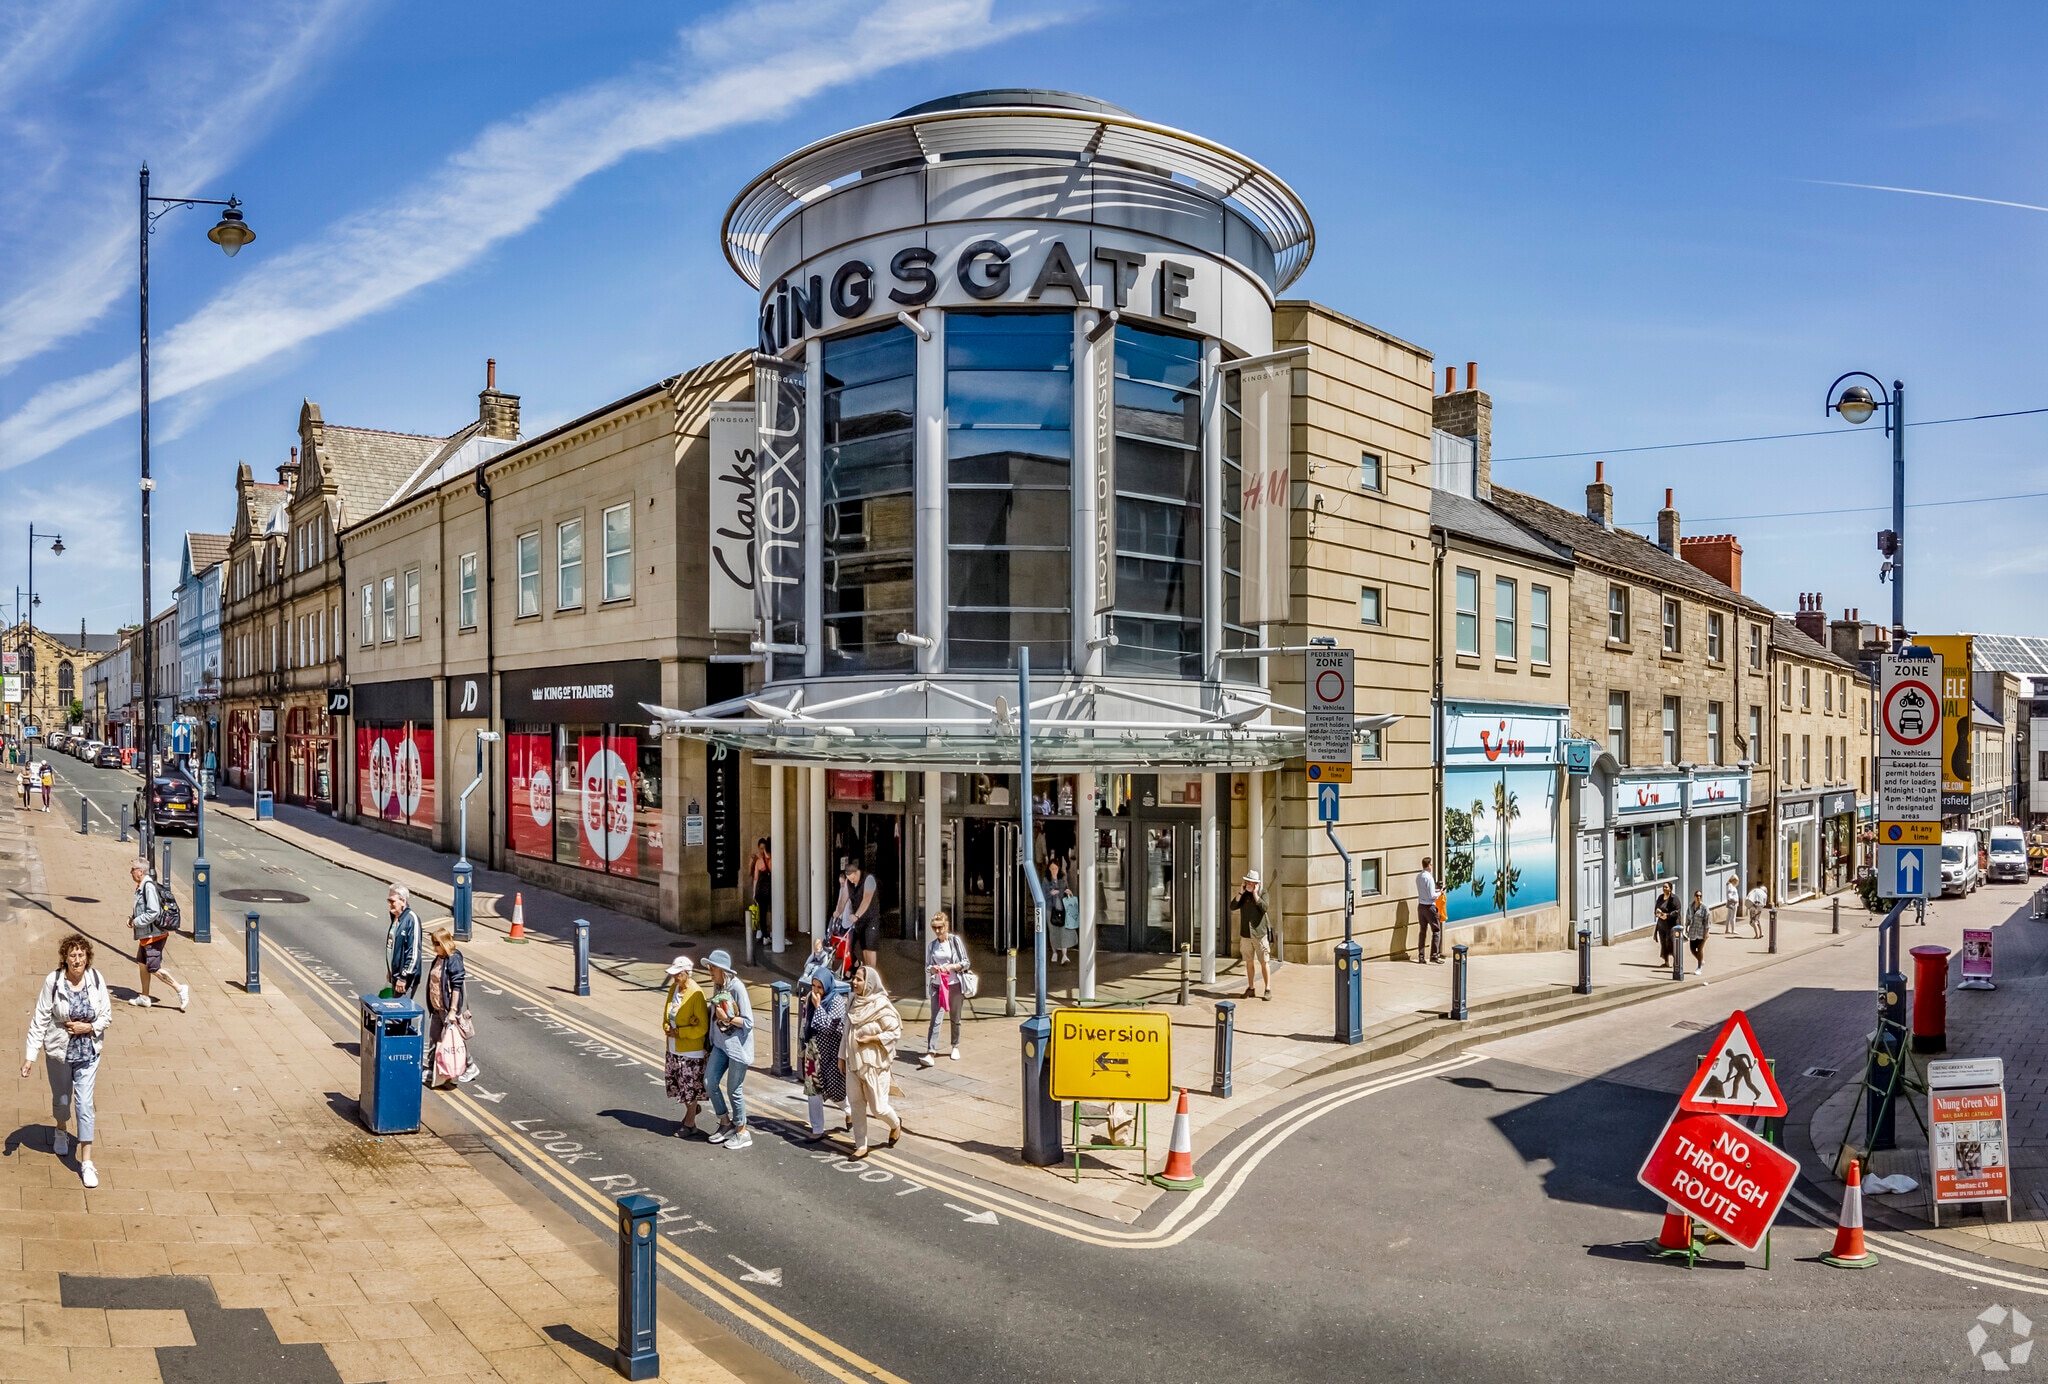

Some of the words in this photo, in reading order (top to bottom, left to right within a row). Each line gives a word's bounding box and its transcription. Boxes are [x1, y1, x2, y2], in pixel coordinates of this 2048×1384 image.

[1098, 359, 1107, 454] FRASER
[1098, 465, 1107, 499] OF
[758, 402, 800, 585] next
[712, 447, 756, 590] Clarks
[1098, 509, 1107, 601] HOUSE
[1315, 658, 1344, 667] ZONE
[1888, 656, 1936, 664] PEDESTRIAN
[1894, 665, 1929, 677] ZONE
[460, 680, 478, 713] JD
[544, 686, 562, 700] KING
[562, 686, 571, 696] OF
[571, 683, 614, 699] TRAINERS
[1943, 678, 1967, 699] ELE
[329, 694, 349, 710] JD
[1315, 715, 1335, 723] Except
[711, 741, 728, 761] JD
[1507, 740, 1525, 758] TUI
[533, 784, 551, 797] SALE
[587, 776, 627, 803] SALE
[1896, 804, 1934, 812] designated
[1942, 795, 1969, 805] rsfield
[1063, 1023, 1159, 1043] Diversion
[443, 1045, 465, 1054] NEXT
[1937, 1098, 1960, 1112] Nhung
[1961, 1097, 1983, 1109] Green
[1983, 1095, 1999, 1107] Nail
[510, 1118, 603, 1165] LOOK
[1715, 1131, 1750, 1163] NO
[1674, 1135, 1769, 1209] THROUGH
[1671, 1169, 1742, 1224] ROUTE
